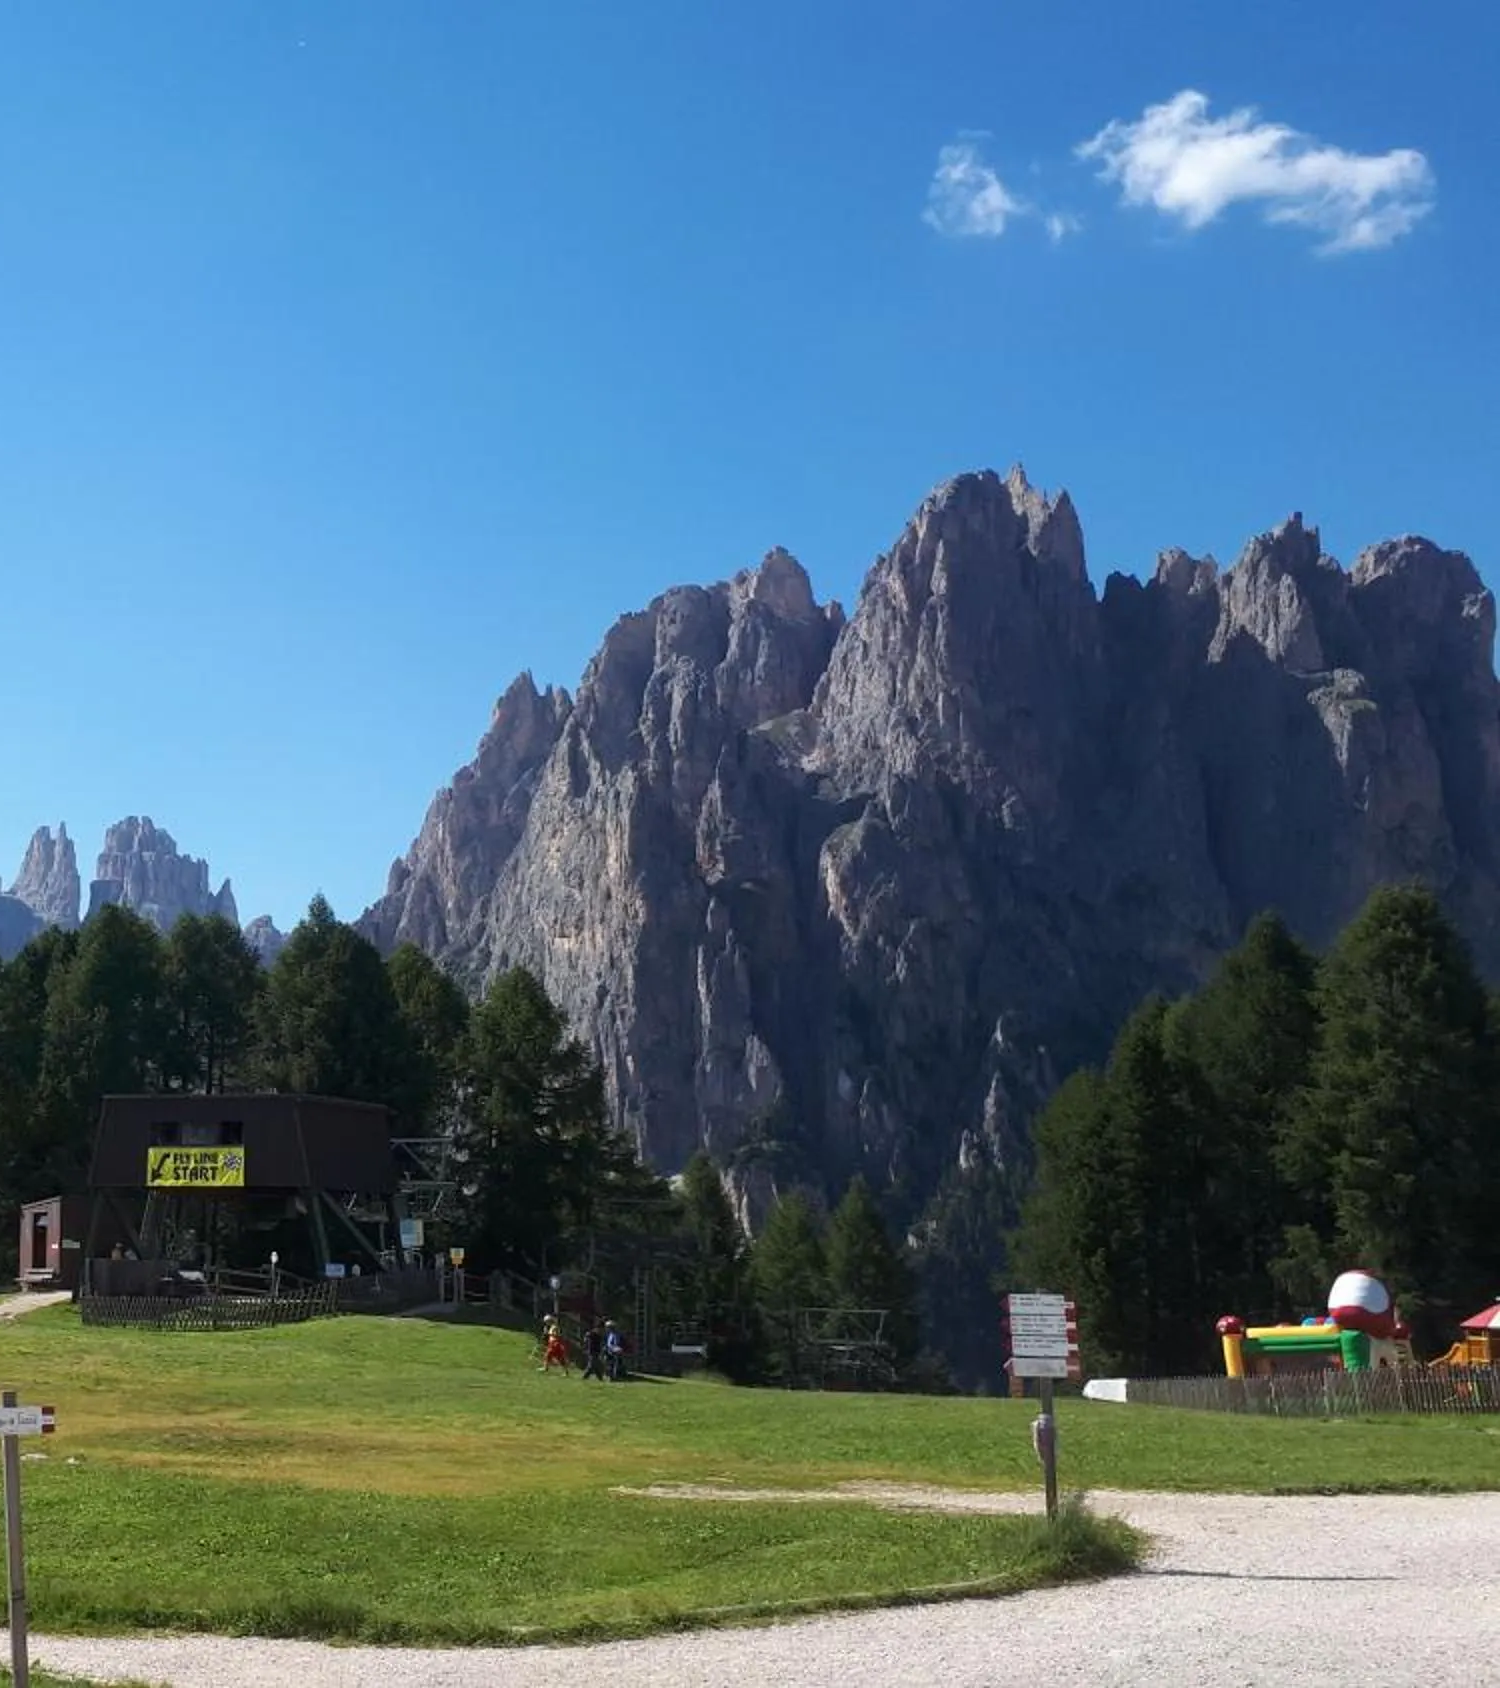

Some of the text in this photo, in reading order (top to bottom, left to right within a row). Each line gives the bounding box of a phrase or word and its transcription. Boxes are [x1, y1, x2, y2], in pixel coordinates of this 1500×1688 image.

[174, 1152, 218, 1164] FLY LINE
[174, 1166, 218, 1181] START
